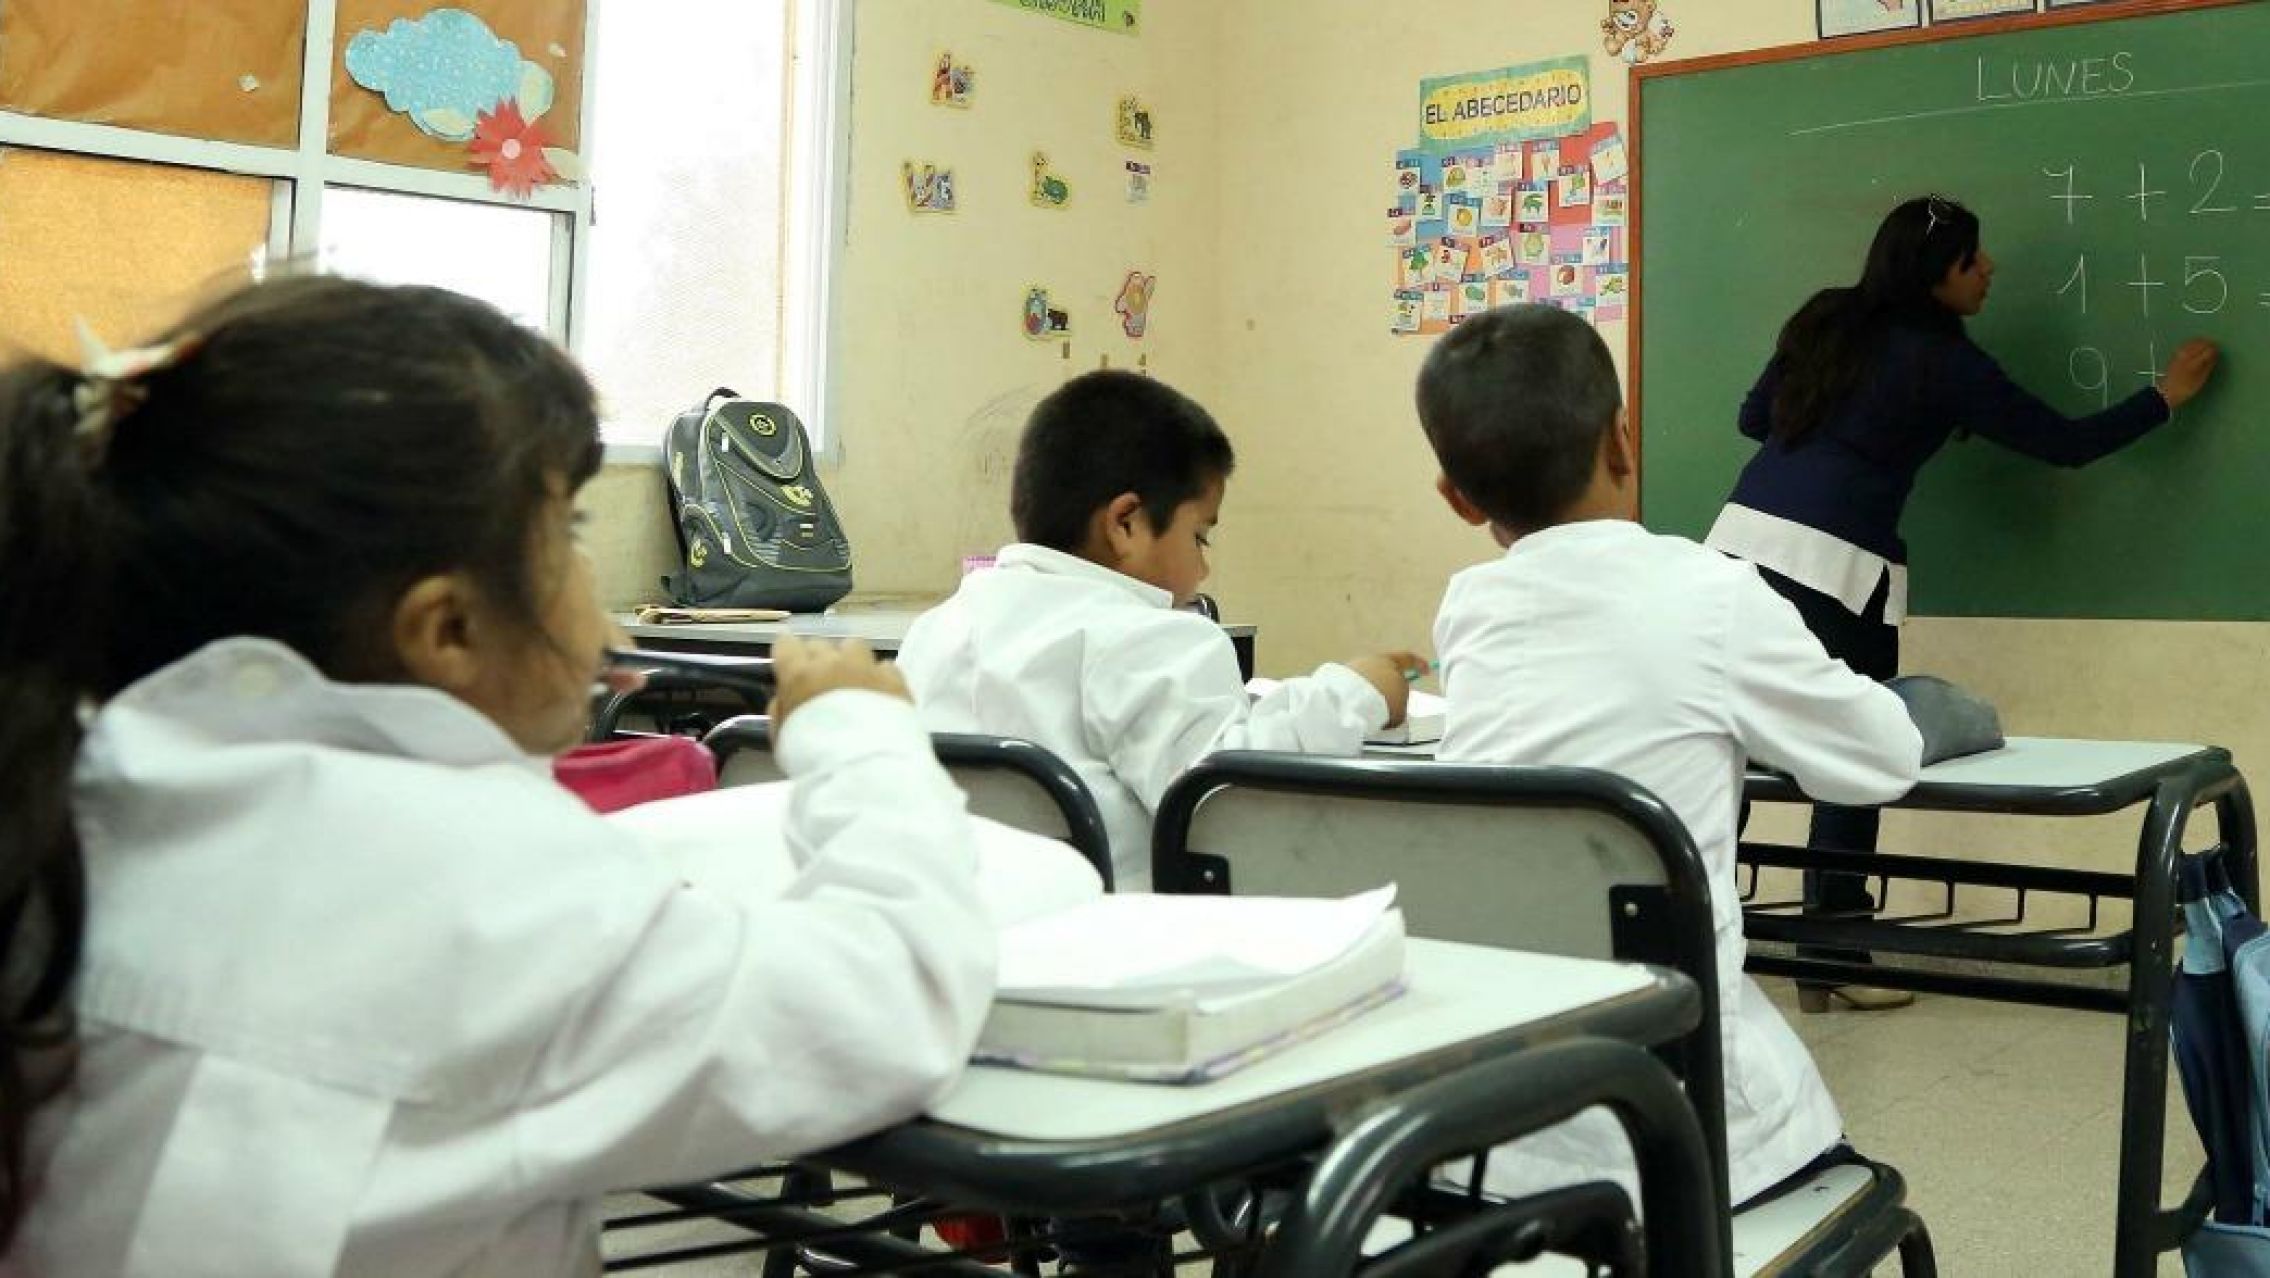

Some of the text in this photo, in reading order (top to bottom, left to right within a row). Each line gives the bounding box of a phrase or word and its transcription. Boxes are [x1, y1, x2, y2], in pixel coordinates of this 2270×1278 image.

[1975, 51, 2134, 101] LUNES
[1425, 84, 1582, 125] EL ABECEDARIO
[2042, 163, 2093, 224] 7
[2188, 149, 2238, 214] 2
[2056, 252, 2086, 314] 1
[2182, 255, 2227, 314] 5
